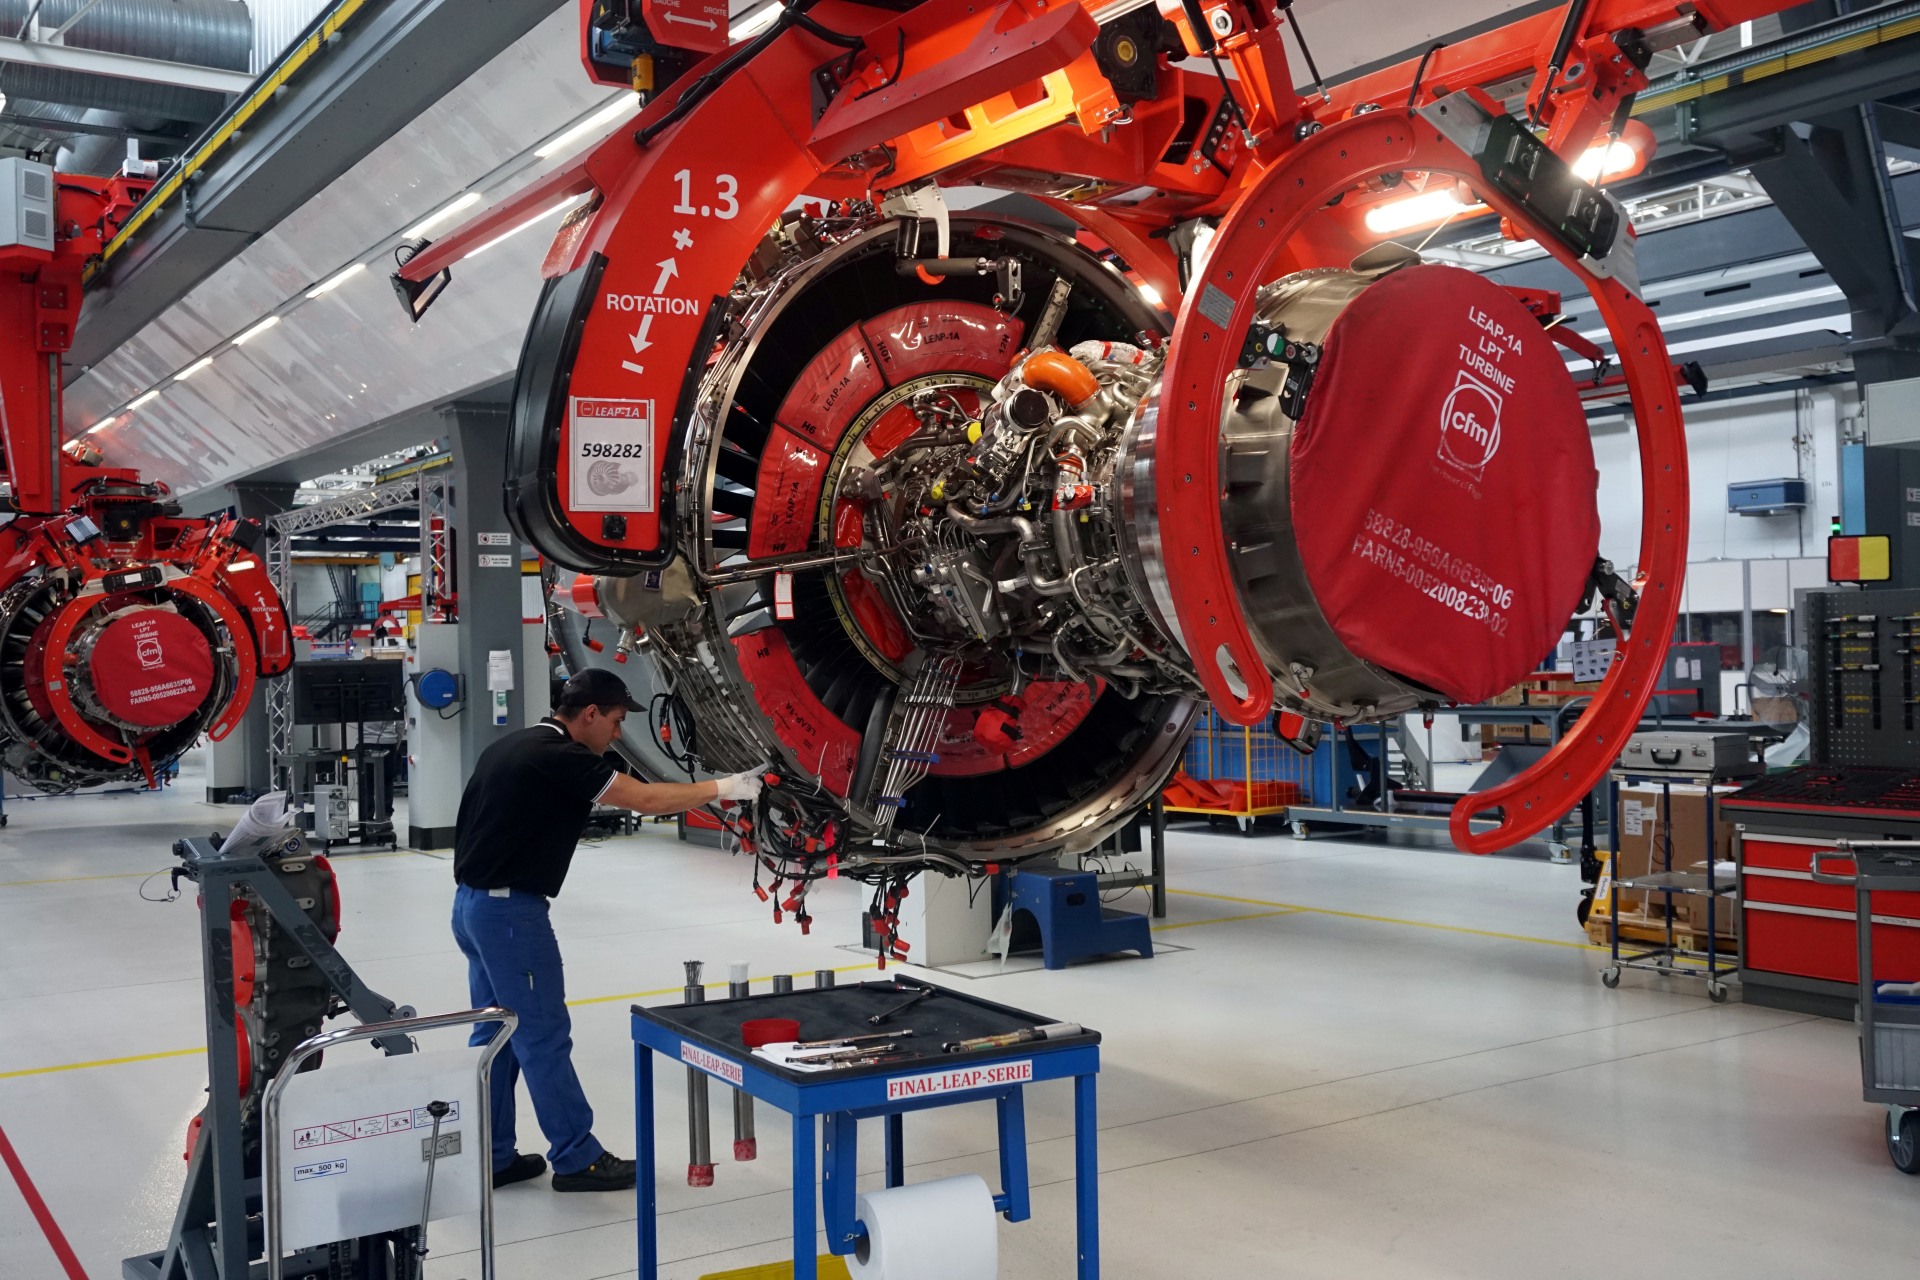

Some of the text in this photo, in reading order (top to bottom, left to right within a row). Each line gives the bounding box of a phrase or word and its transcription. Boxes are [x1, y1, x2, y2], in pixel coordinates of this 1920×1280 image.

[703, 6, 727, 16] DROITE
[673, 169, 739, 220] 1.3
[606, 293, 699, 315] ROTATION
[923, 332, 961, 345] LEAP-1A
[1468, 306, 1522, 356] LEAP-1A
[876, 341, 892, 363] 10H
[1478, 336, 1505, 363] LPT
[1459, 344, 1516, 394] TURBINE
[822, 377, 851, 412] LEAP-1A
[595, 406, 640, 418] LEAP-1A
[1452, 411, 1489, 447] cfm
[581, 443, 643, 458] 598282
[785, 481, 800, 525] LEAP-1A
[131, 619, 157, 629] LEAP-1A
[133, 631, 159, 640] TURBINE
[141, 648, 158, 657] cfm
[785, 701, 817, 737] LEAP-1A
[681, 1044, 742, 1084] FINAL-LEAP-SERIE
[889, 1064, 1031, 1098] FINAL-LEAP-SERIE
[318, 1163, 332, 1171] 500
[335, 1162, 345, 1170] kg
